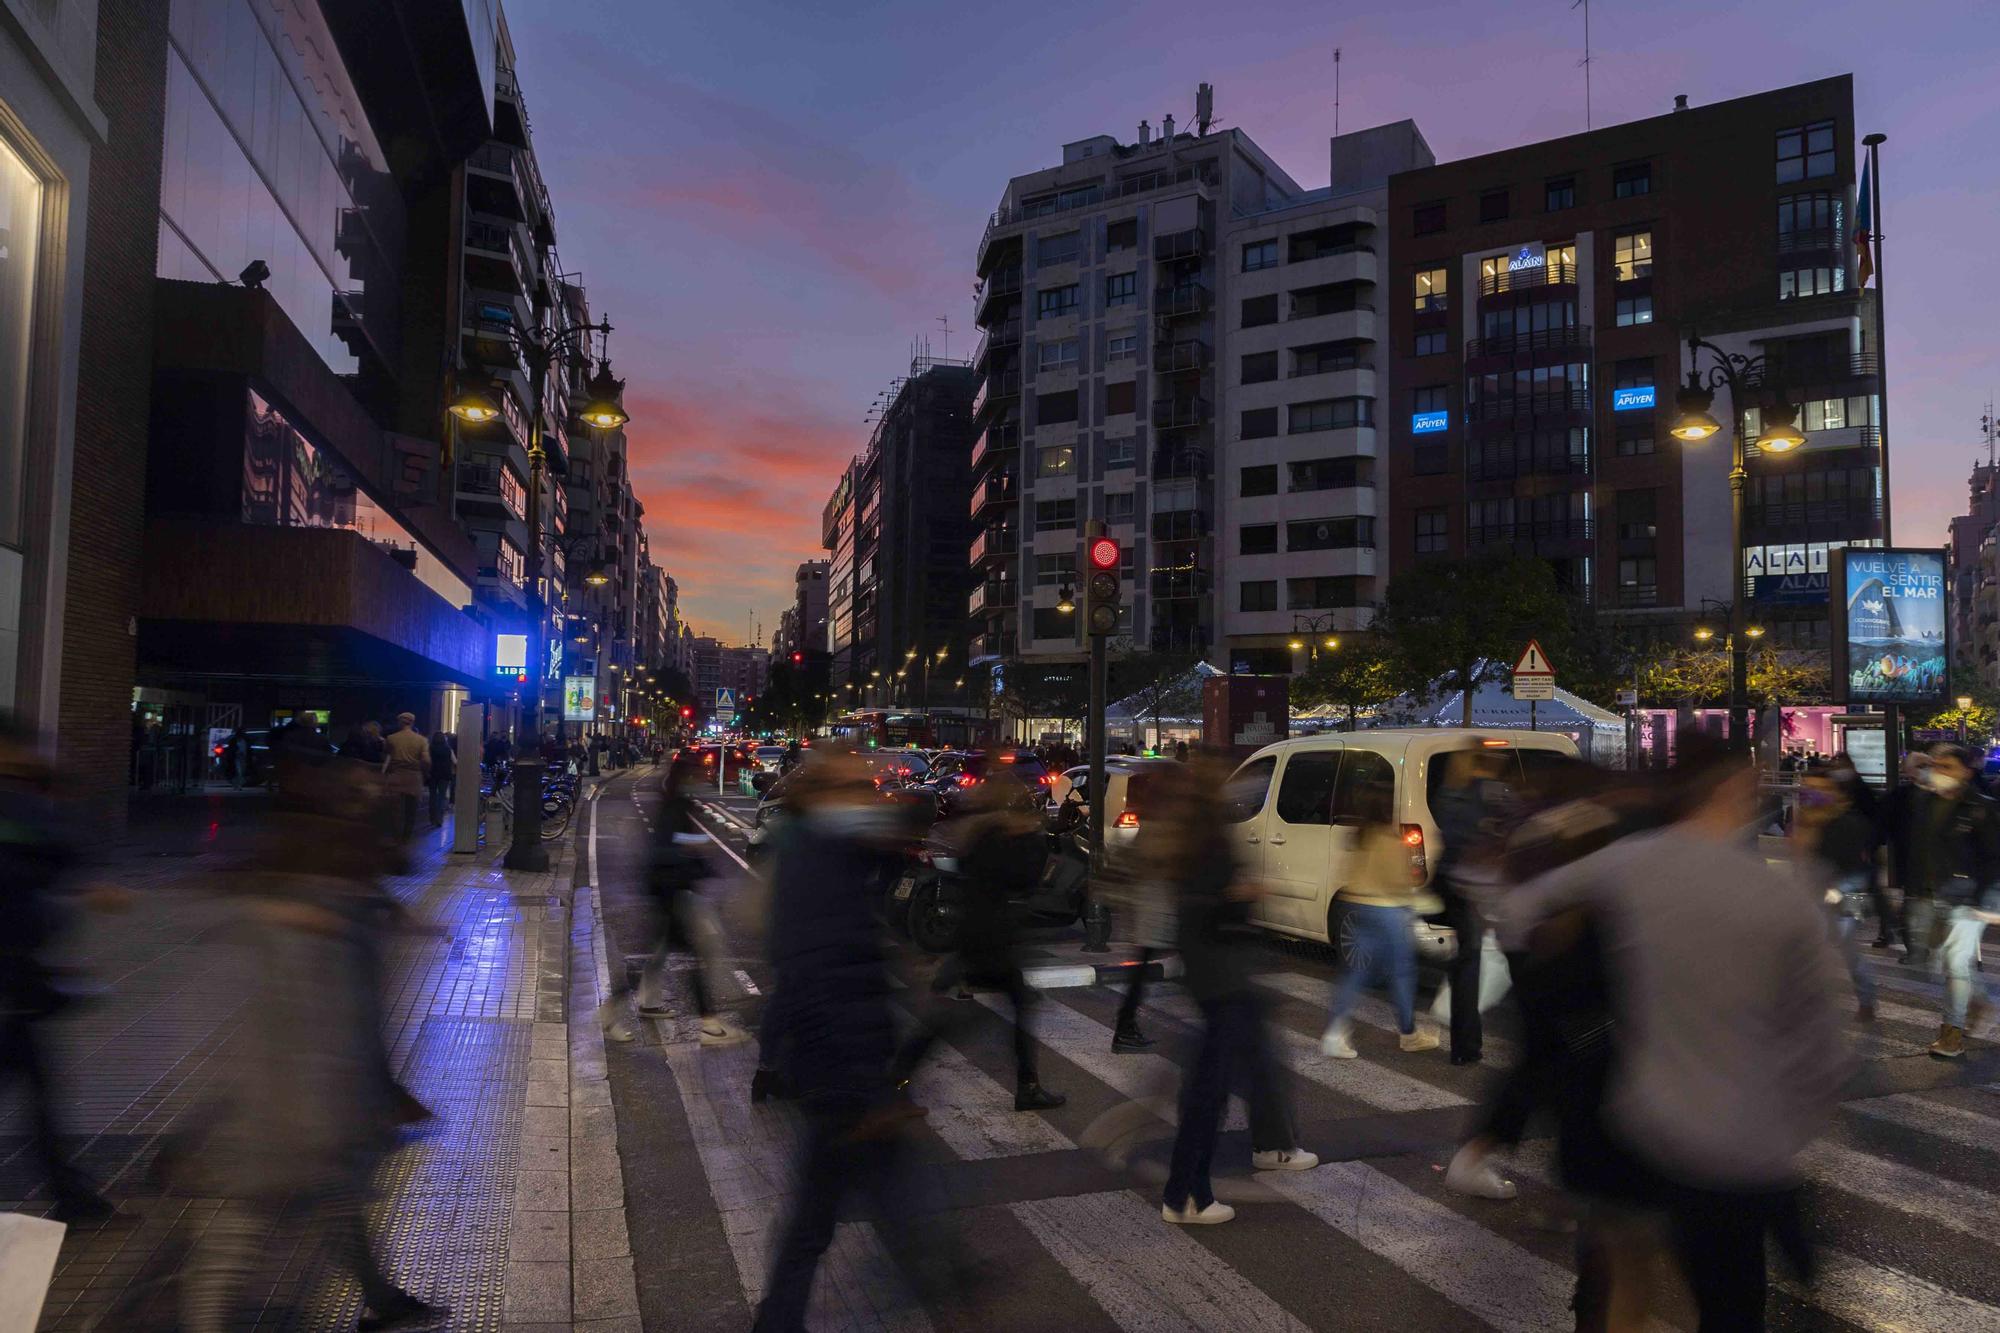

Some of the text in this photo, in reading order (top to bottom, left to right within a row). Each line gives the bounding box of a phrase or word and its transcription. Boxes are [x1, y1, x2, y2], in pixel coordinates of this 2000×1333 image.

[1509, 256, 1543, 271] ALAIN
[1617, 394, 1653, 406] APUYEN
[1415, 418, 1446, 429] APUYEN
[1747, 550, 1821, 569] ALAI
[1852, 562, 1921, 574] VUELVE A
[1889, 574, 1942, 587] SENTIR
[1882, 586, 1938, 599] EL MAR
